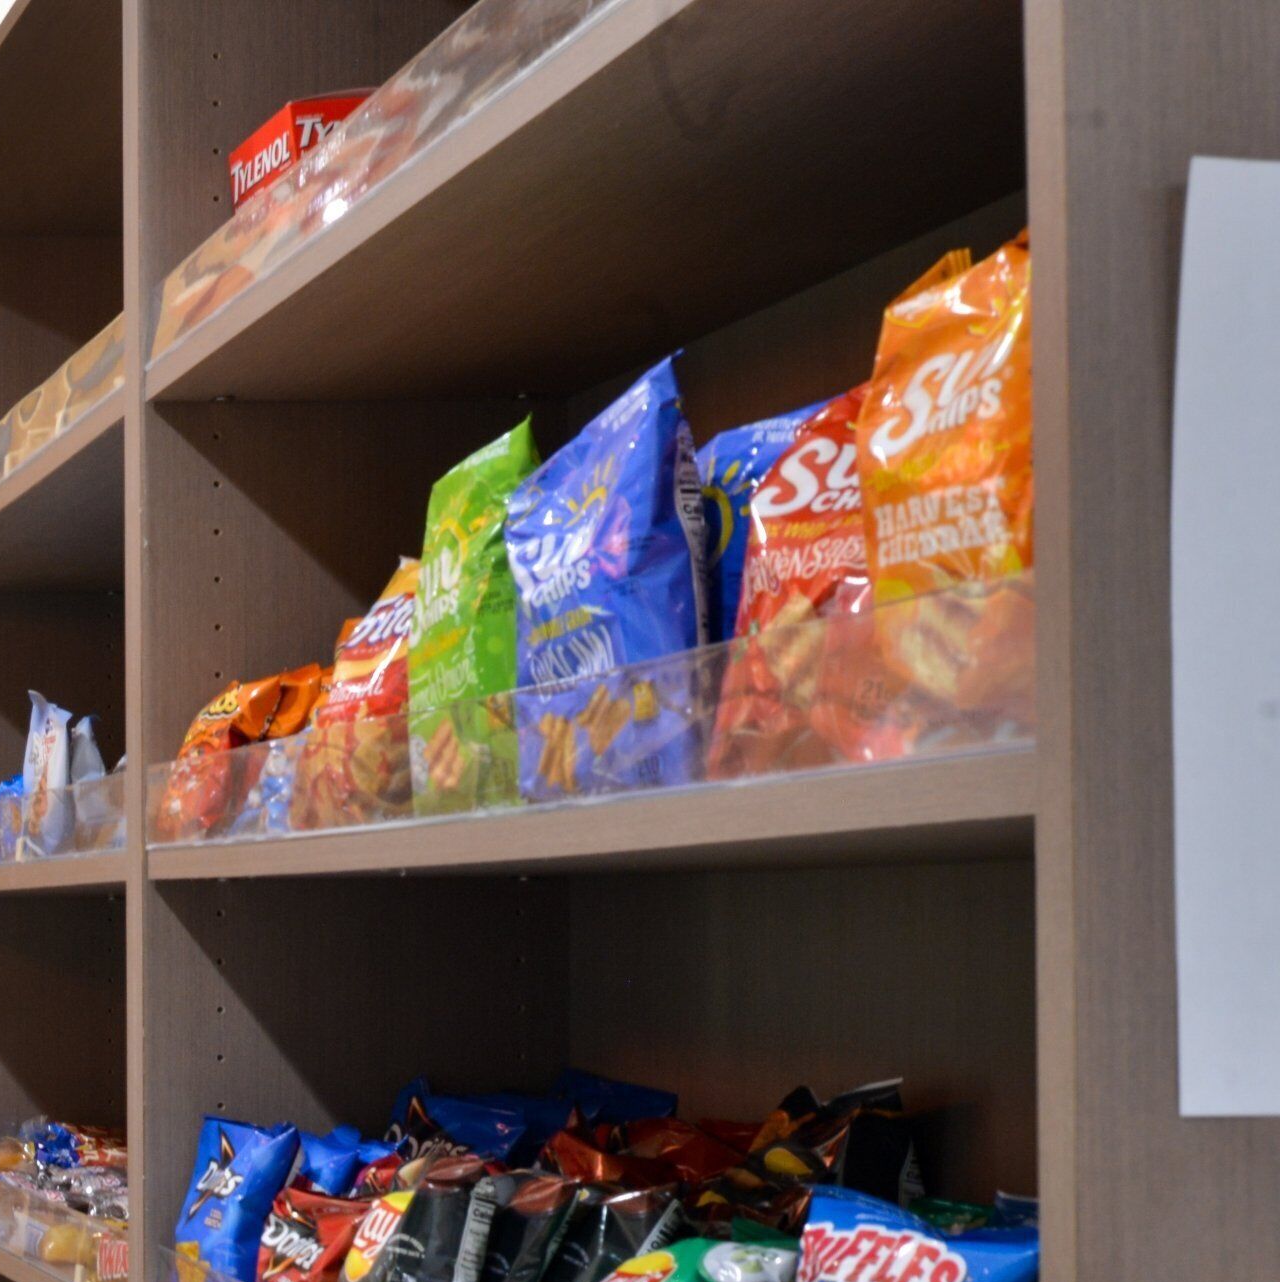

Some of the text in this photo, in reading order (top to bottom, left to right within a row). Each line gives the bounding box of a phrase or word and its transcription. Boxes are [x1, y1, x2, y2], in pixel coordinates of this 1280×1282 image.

[230, 132, 292, 203] TYLENOL
[869, 338, 1014, 460] SUN
[926, 379, 1004, 435] HIPS
[753, 437, 861, 518] SU
[874, 478, 1007, 542] HARVEST
[877, 510, 1012, 569] CHEDDAR
[527, 556, 591, 605] CHIPS
